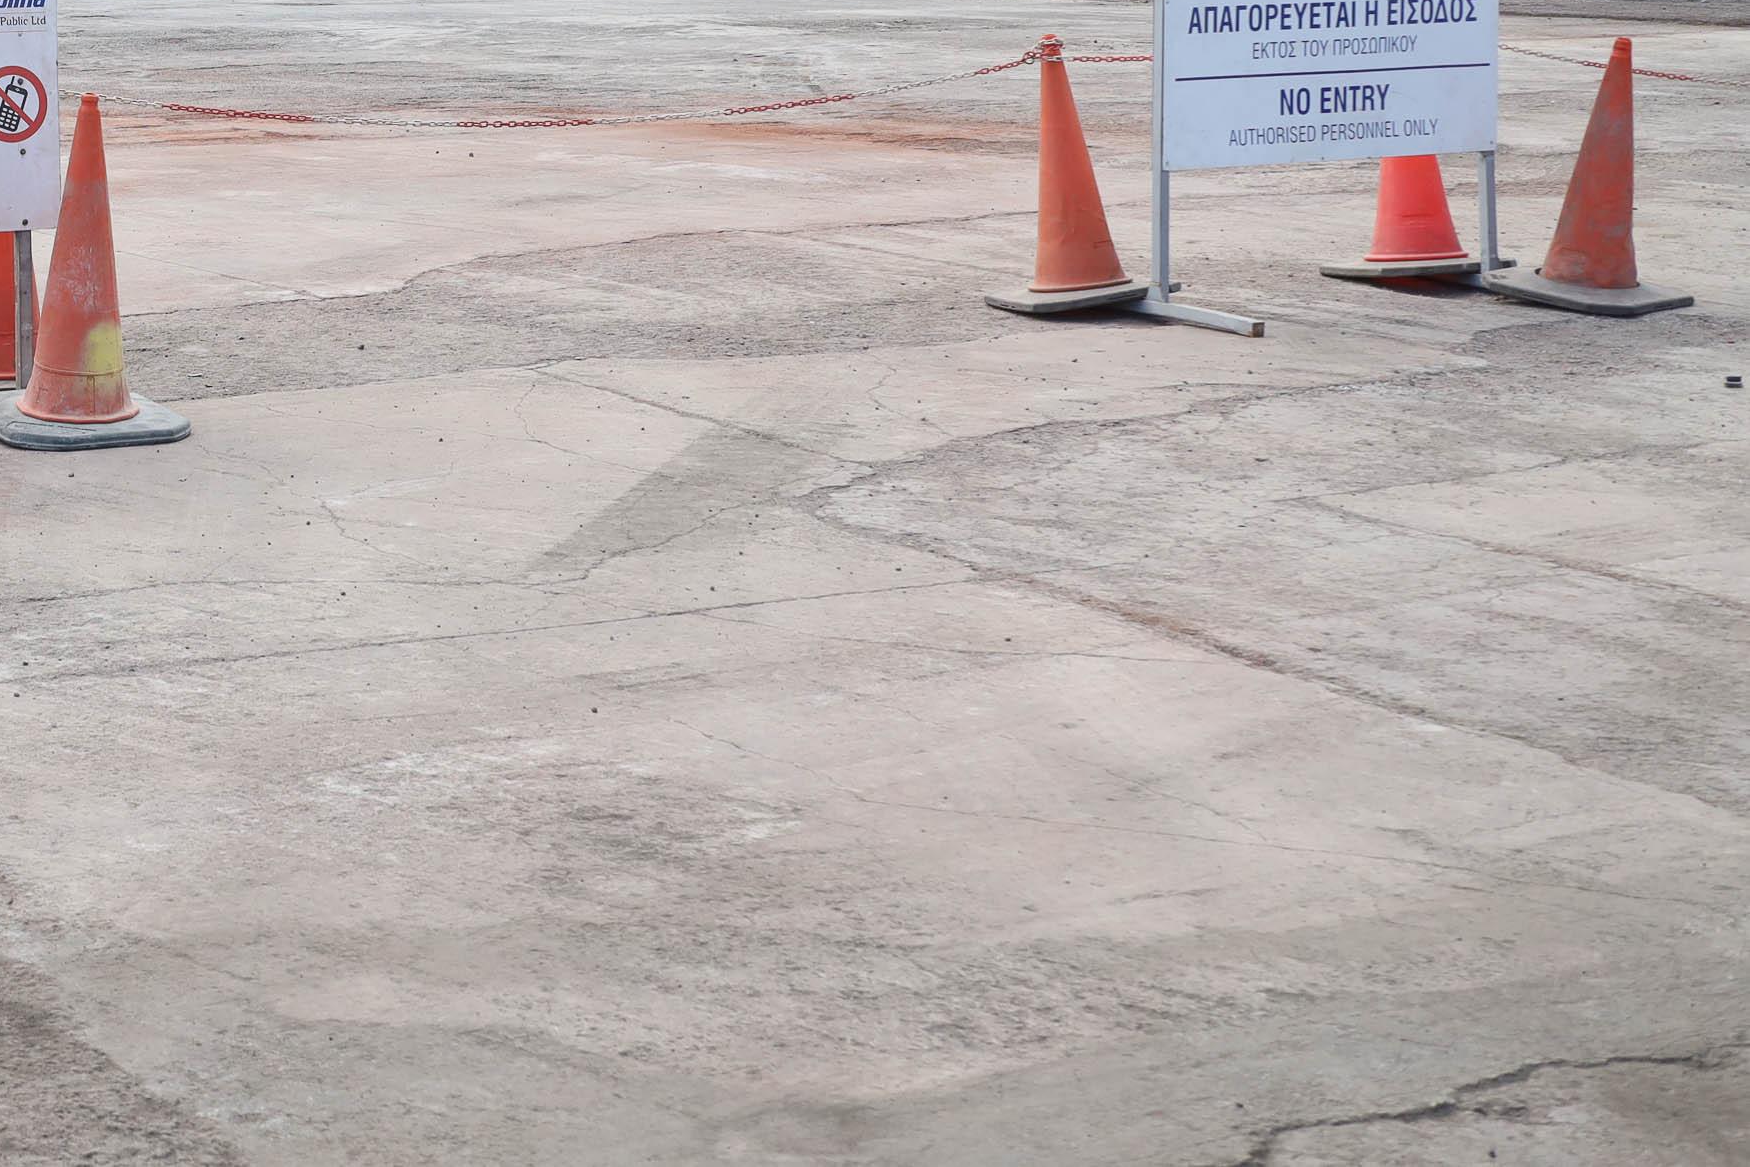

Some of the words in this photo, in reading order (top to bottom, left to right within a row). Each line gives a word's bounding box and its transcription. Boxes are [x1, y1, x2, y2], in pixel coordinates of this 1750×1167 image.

[0, 16, 28, 26] Public
[31, 15, 46, 25] Ltd
[1188, 1, 1356, 34] ΑΠΑΓΟΡΕΥΕΤΑΙ
[1365, 0, 1378, 26] Η
[1252, 40, 1296, 60] ΕΚΤΟΣ
[1301, 38, 1329, 57] ΤΟΥ
[1333, 35, 1418, 56] ΠΡΟΣΩΠΙΚΟΥ
[1280, 87, 1311, 116] NO
[1320, 84, 1390, 114] ENTRY
[1228, 125, 1316, 147] AUTHORISED
[1322, 120, 1399, 142] PERSONNEL
[1403, 118, 1438, 137] ONLY
